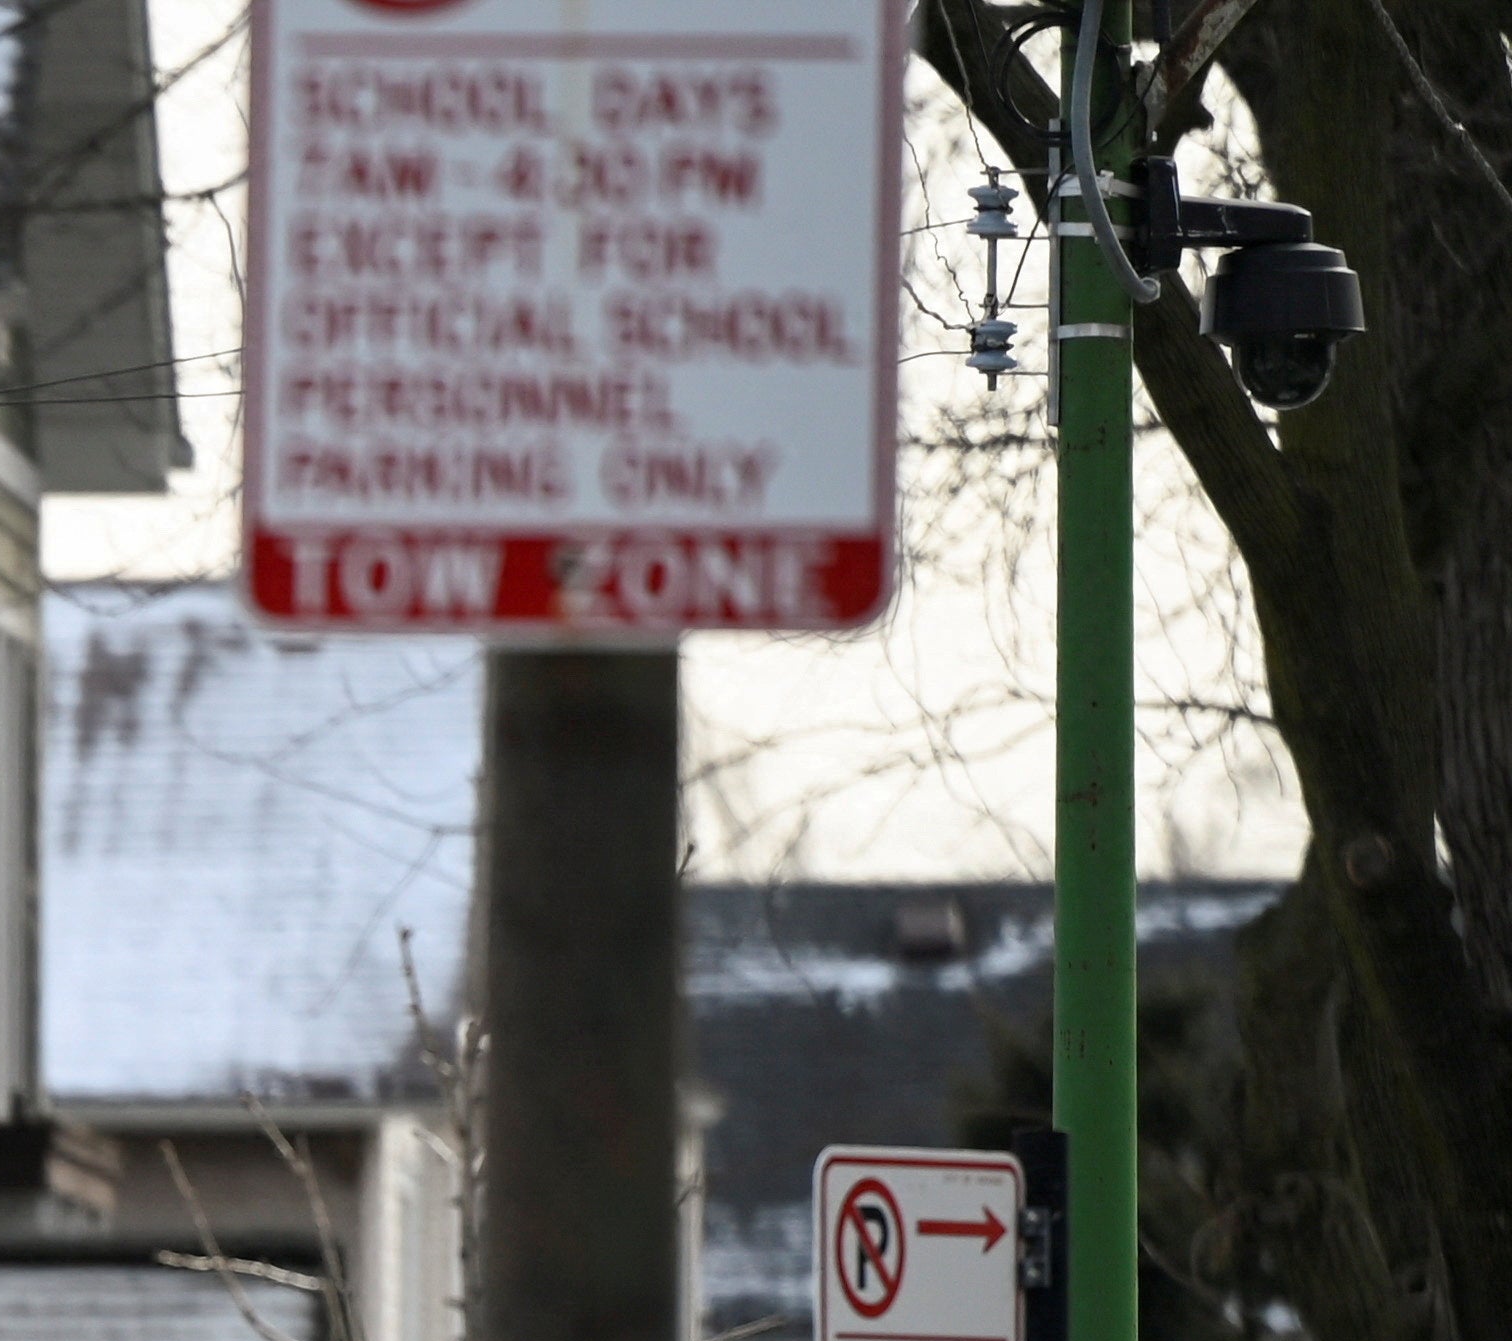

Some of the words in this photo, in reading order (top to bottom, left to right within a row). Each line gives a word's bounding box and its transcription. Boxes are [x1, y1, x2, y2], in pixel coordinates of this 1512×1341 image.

[295, 68, 548, 134] SCHOOL
[591, 69, 777, 136] DAYS
[288, 214, 544, 276] EXCEPT
[578, 216, 719, 281] FOR
[283, 291, 577, 358] OFFICIAL
[601, 294, 858, 364] SCHOOL
[280, 367, 682, 433] PERSONNEL
[277, 438, 572, 501] PARKING
[600, 443, 779, 505] ONLY
[288, 540, 505, 617] TOW
[556, 540, 834, 619] ZONE
